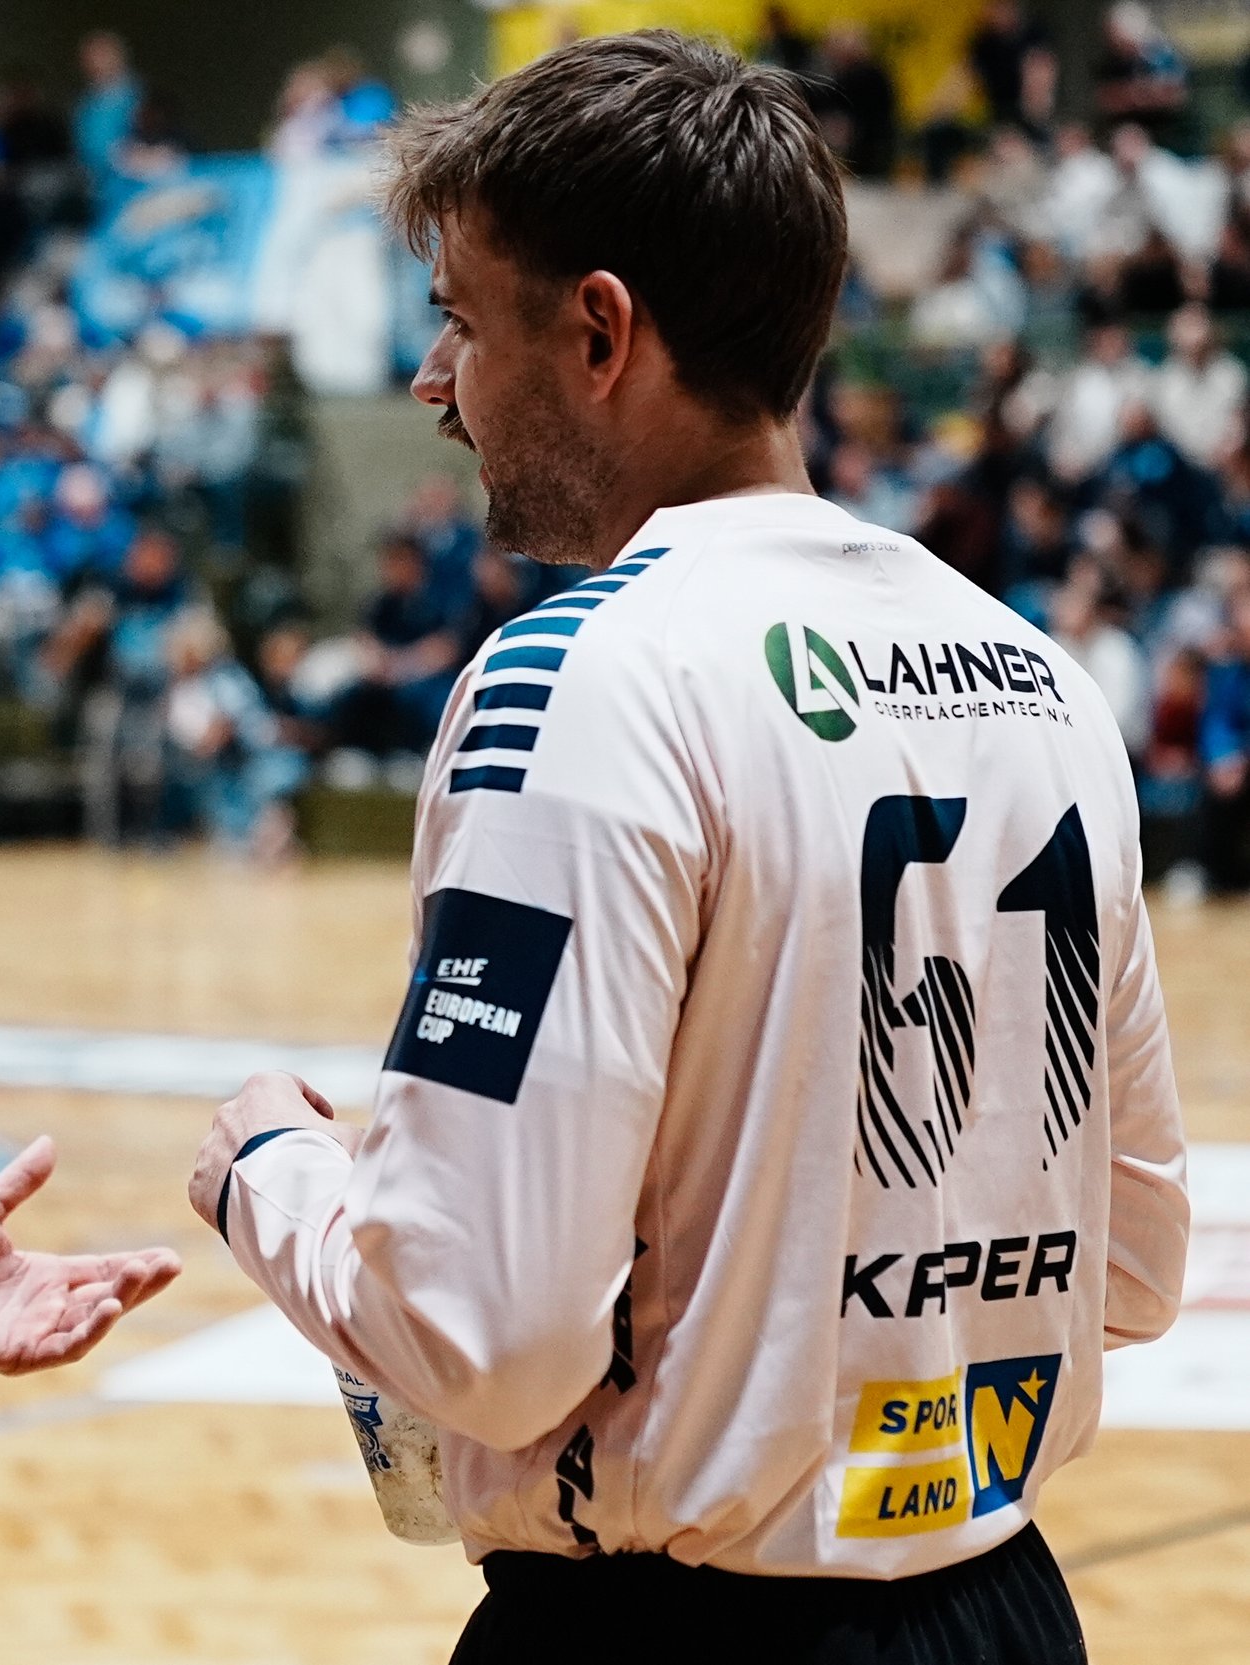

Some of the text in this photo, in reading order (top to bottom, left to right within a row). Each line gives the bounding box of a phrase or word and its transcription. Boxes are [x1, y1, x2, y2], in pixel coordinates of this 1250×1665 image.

[847, 640, 1066, 704] LAHNER
[436, 958, 489, 977] EHF
[424, 988, 522, 1038] EUROPEAN
[853, 794, 1100, 1190] 61
[416, 1014, 454, 1044] CUP
[878, 1393, 958, 1434] SPOR
[878, 1477, 958, 1521] LAND
